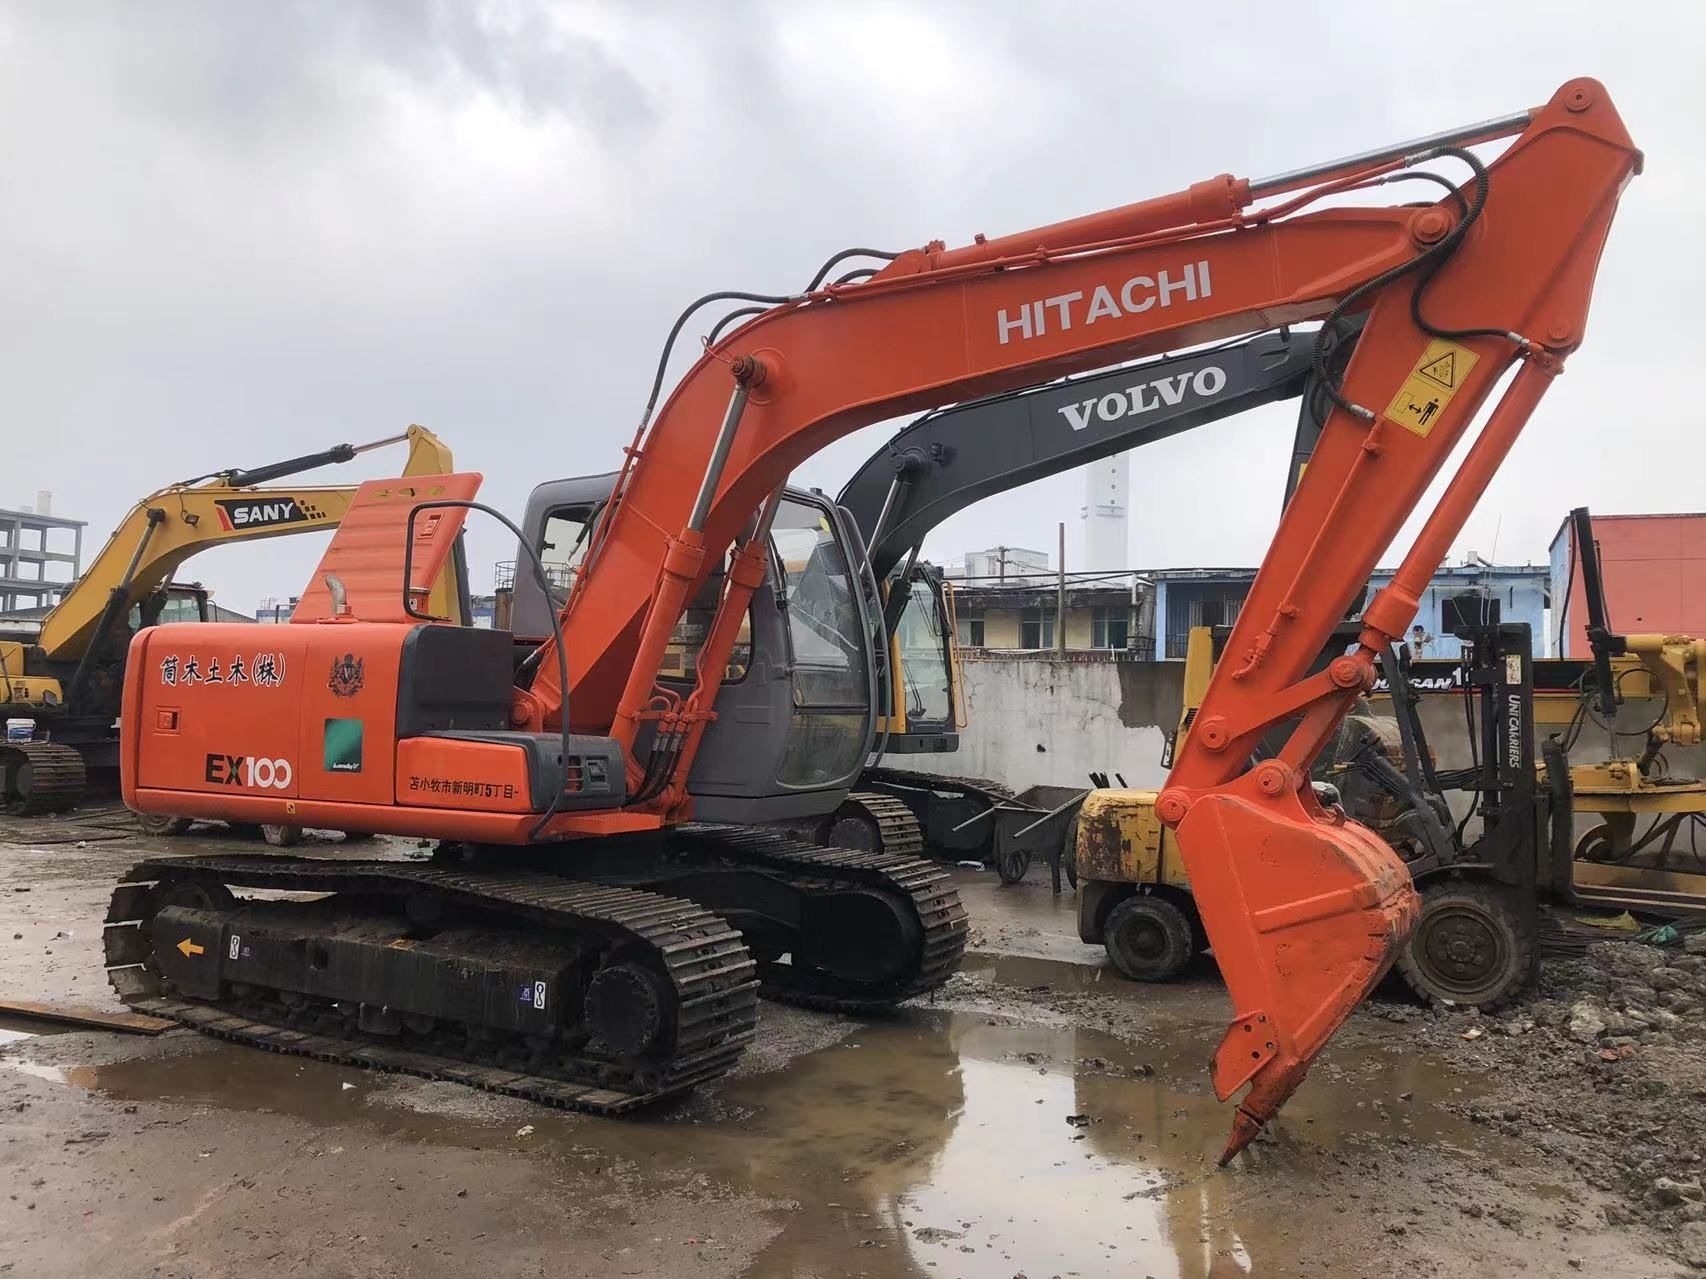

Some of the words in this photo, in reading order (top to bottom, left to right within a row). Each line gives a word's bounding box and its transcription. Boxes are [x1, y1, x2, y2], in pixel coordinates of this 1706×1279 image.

[997, 260, 1212, 345] HITACHI
[1057, 366, 1227, 431] VOLVO
[234, 502, 294, 524] SANY
[205, 753, 292, 789] EX100
